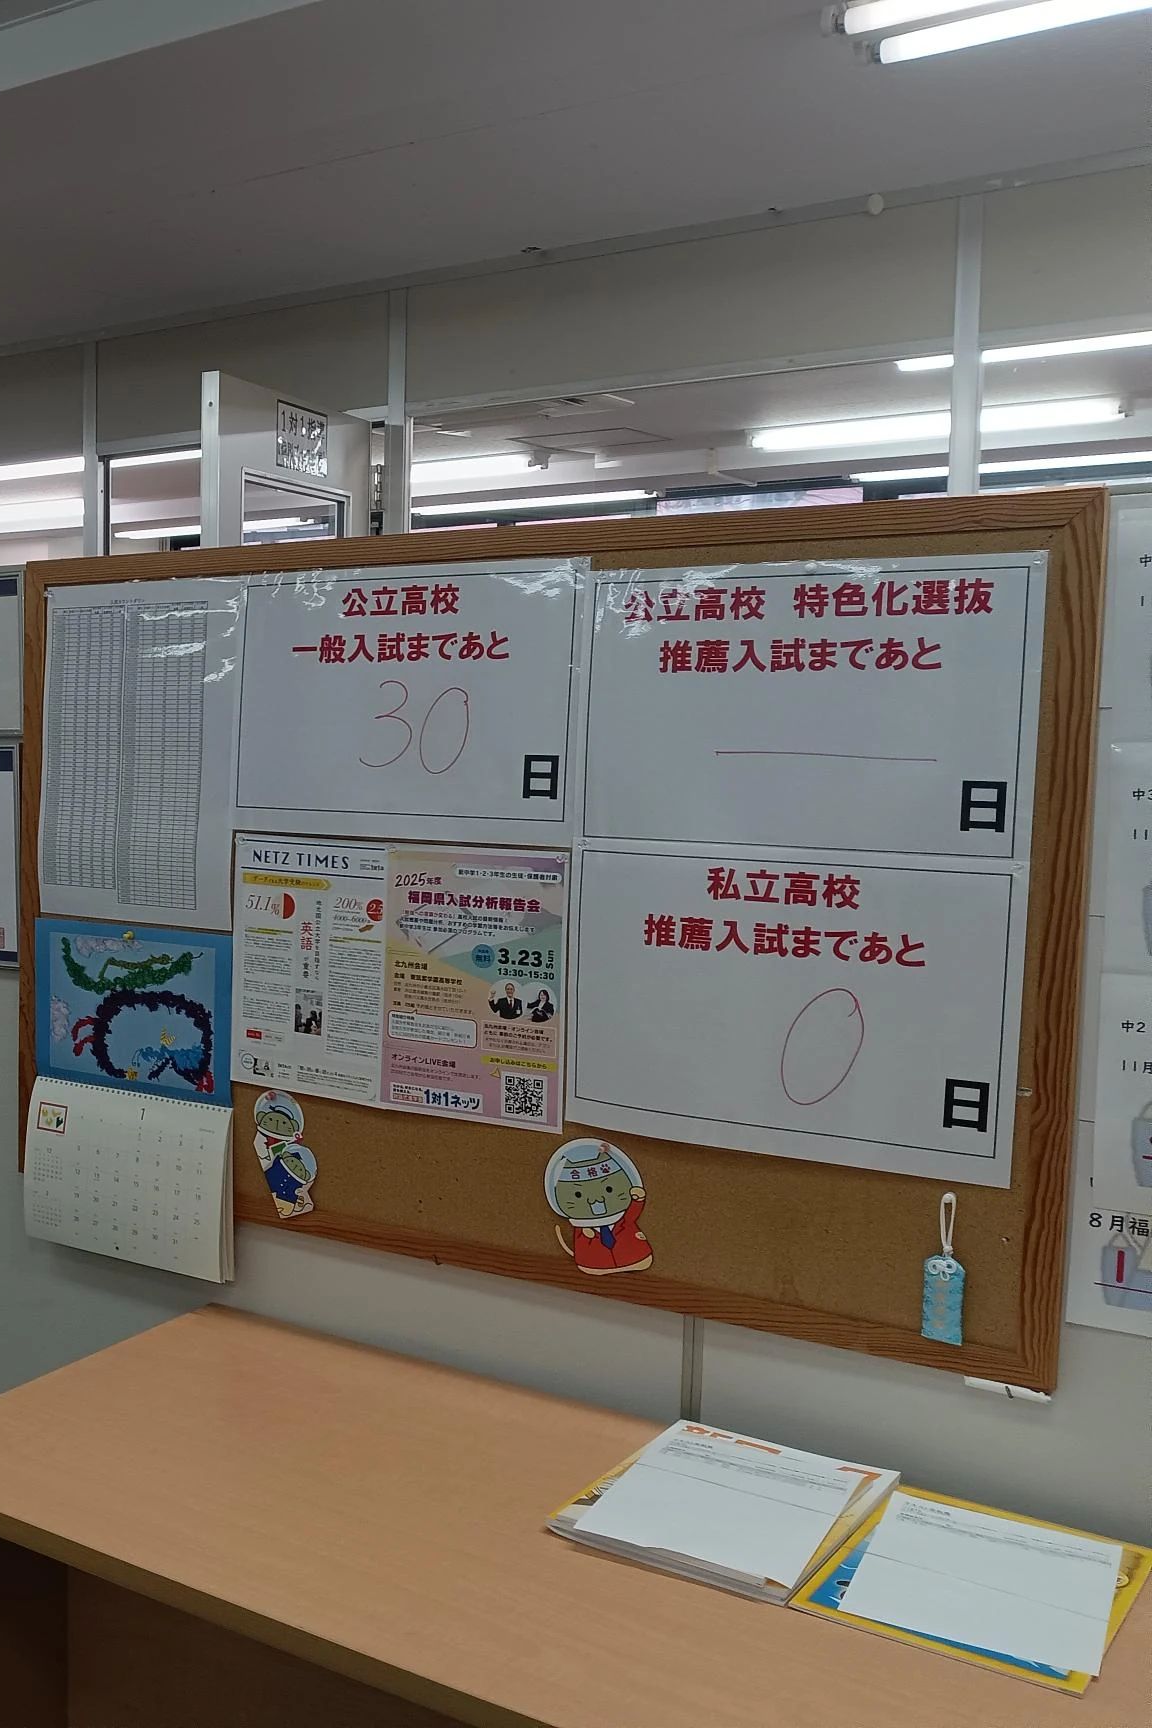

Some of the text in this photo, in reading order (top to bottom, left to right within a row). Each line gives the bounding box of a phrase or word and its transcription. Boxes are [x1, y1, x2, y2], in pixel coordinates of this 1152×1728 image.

[342, 584, 459, 618] 公立高校
[623, 578, 994, 623] 公立高校 特色化選抜
[292, 631, 509, 663] 一般入試まであと
[659, 636, 943, 674] 推薦入試まであと
[359, 680, 469, 774] 30
[522, 754, 559, 800] 日
[959, 780, 1008, 833] 日
[252, 849, 290, 866] NETZ
[296, 852, 350, 870] TIMES
[394, 872, 442, 888] 2025年度
[706, 866, 860, 910] 私立高校
[245, 894, 280, 916] 51.1%
[333, 896, 363, 911] 200%
[408, 889, 541, 913] 福岡県入試分析報告会
[300, 921, 314, 951] 英語
[644, 913, 926, 967] 推薦入試まであと
[394, 960, 428, 971] 北九州会場
[497, 948, 555, 969] 3.23 Sun
[497, 967, 555, 981] 13:30-15:30
[1121, 1019, 1146, 1033] 中2
[781, 988, 864, 1105] 0
[391, 1053, 456, 1069] オンラインLIVE会場
[424, 1088, 480, 1110] 1対1ネッツ
[943, 1077, 990, 1133] 日
[569, 1167, 608, 1180] 合格
[1088, 1212, 1151, 1238] 8月福
